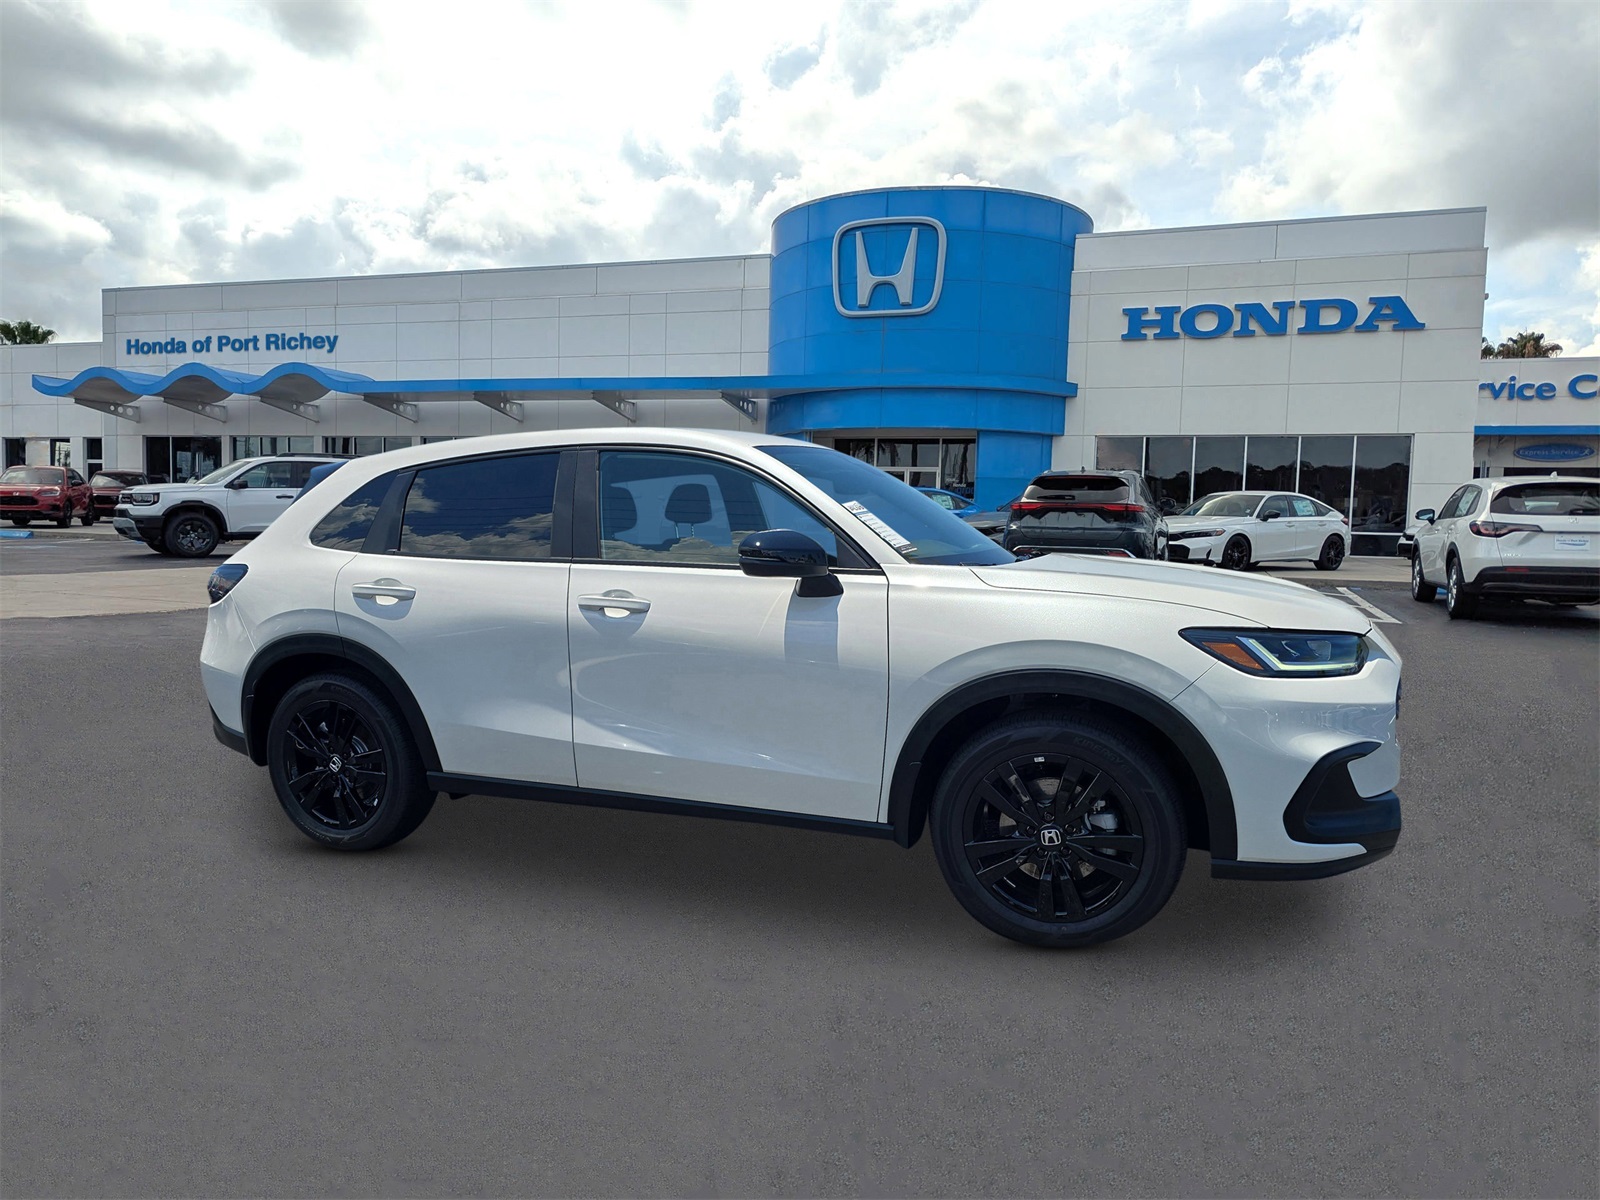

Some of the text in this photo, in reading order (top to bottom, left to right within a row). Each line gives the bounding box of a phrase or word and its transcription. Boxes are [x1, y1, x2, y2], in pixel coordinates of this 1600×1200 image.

[1121, 296, 1425, 341] HONDA
[126, 332, 339, 355] Honda of Port Richey
